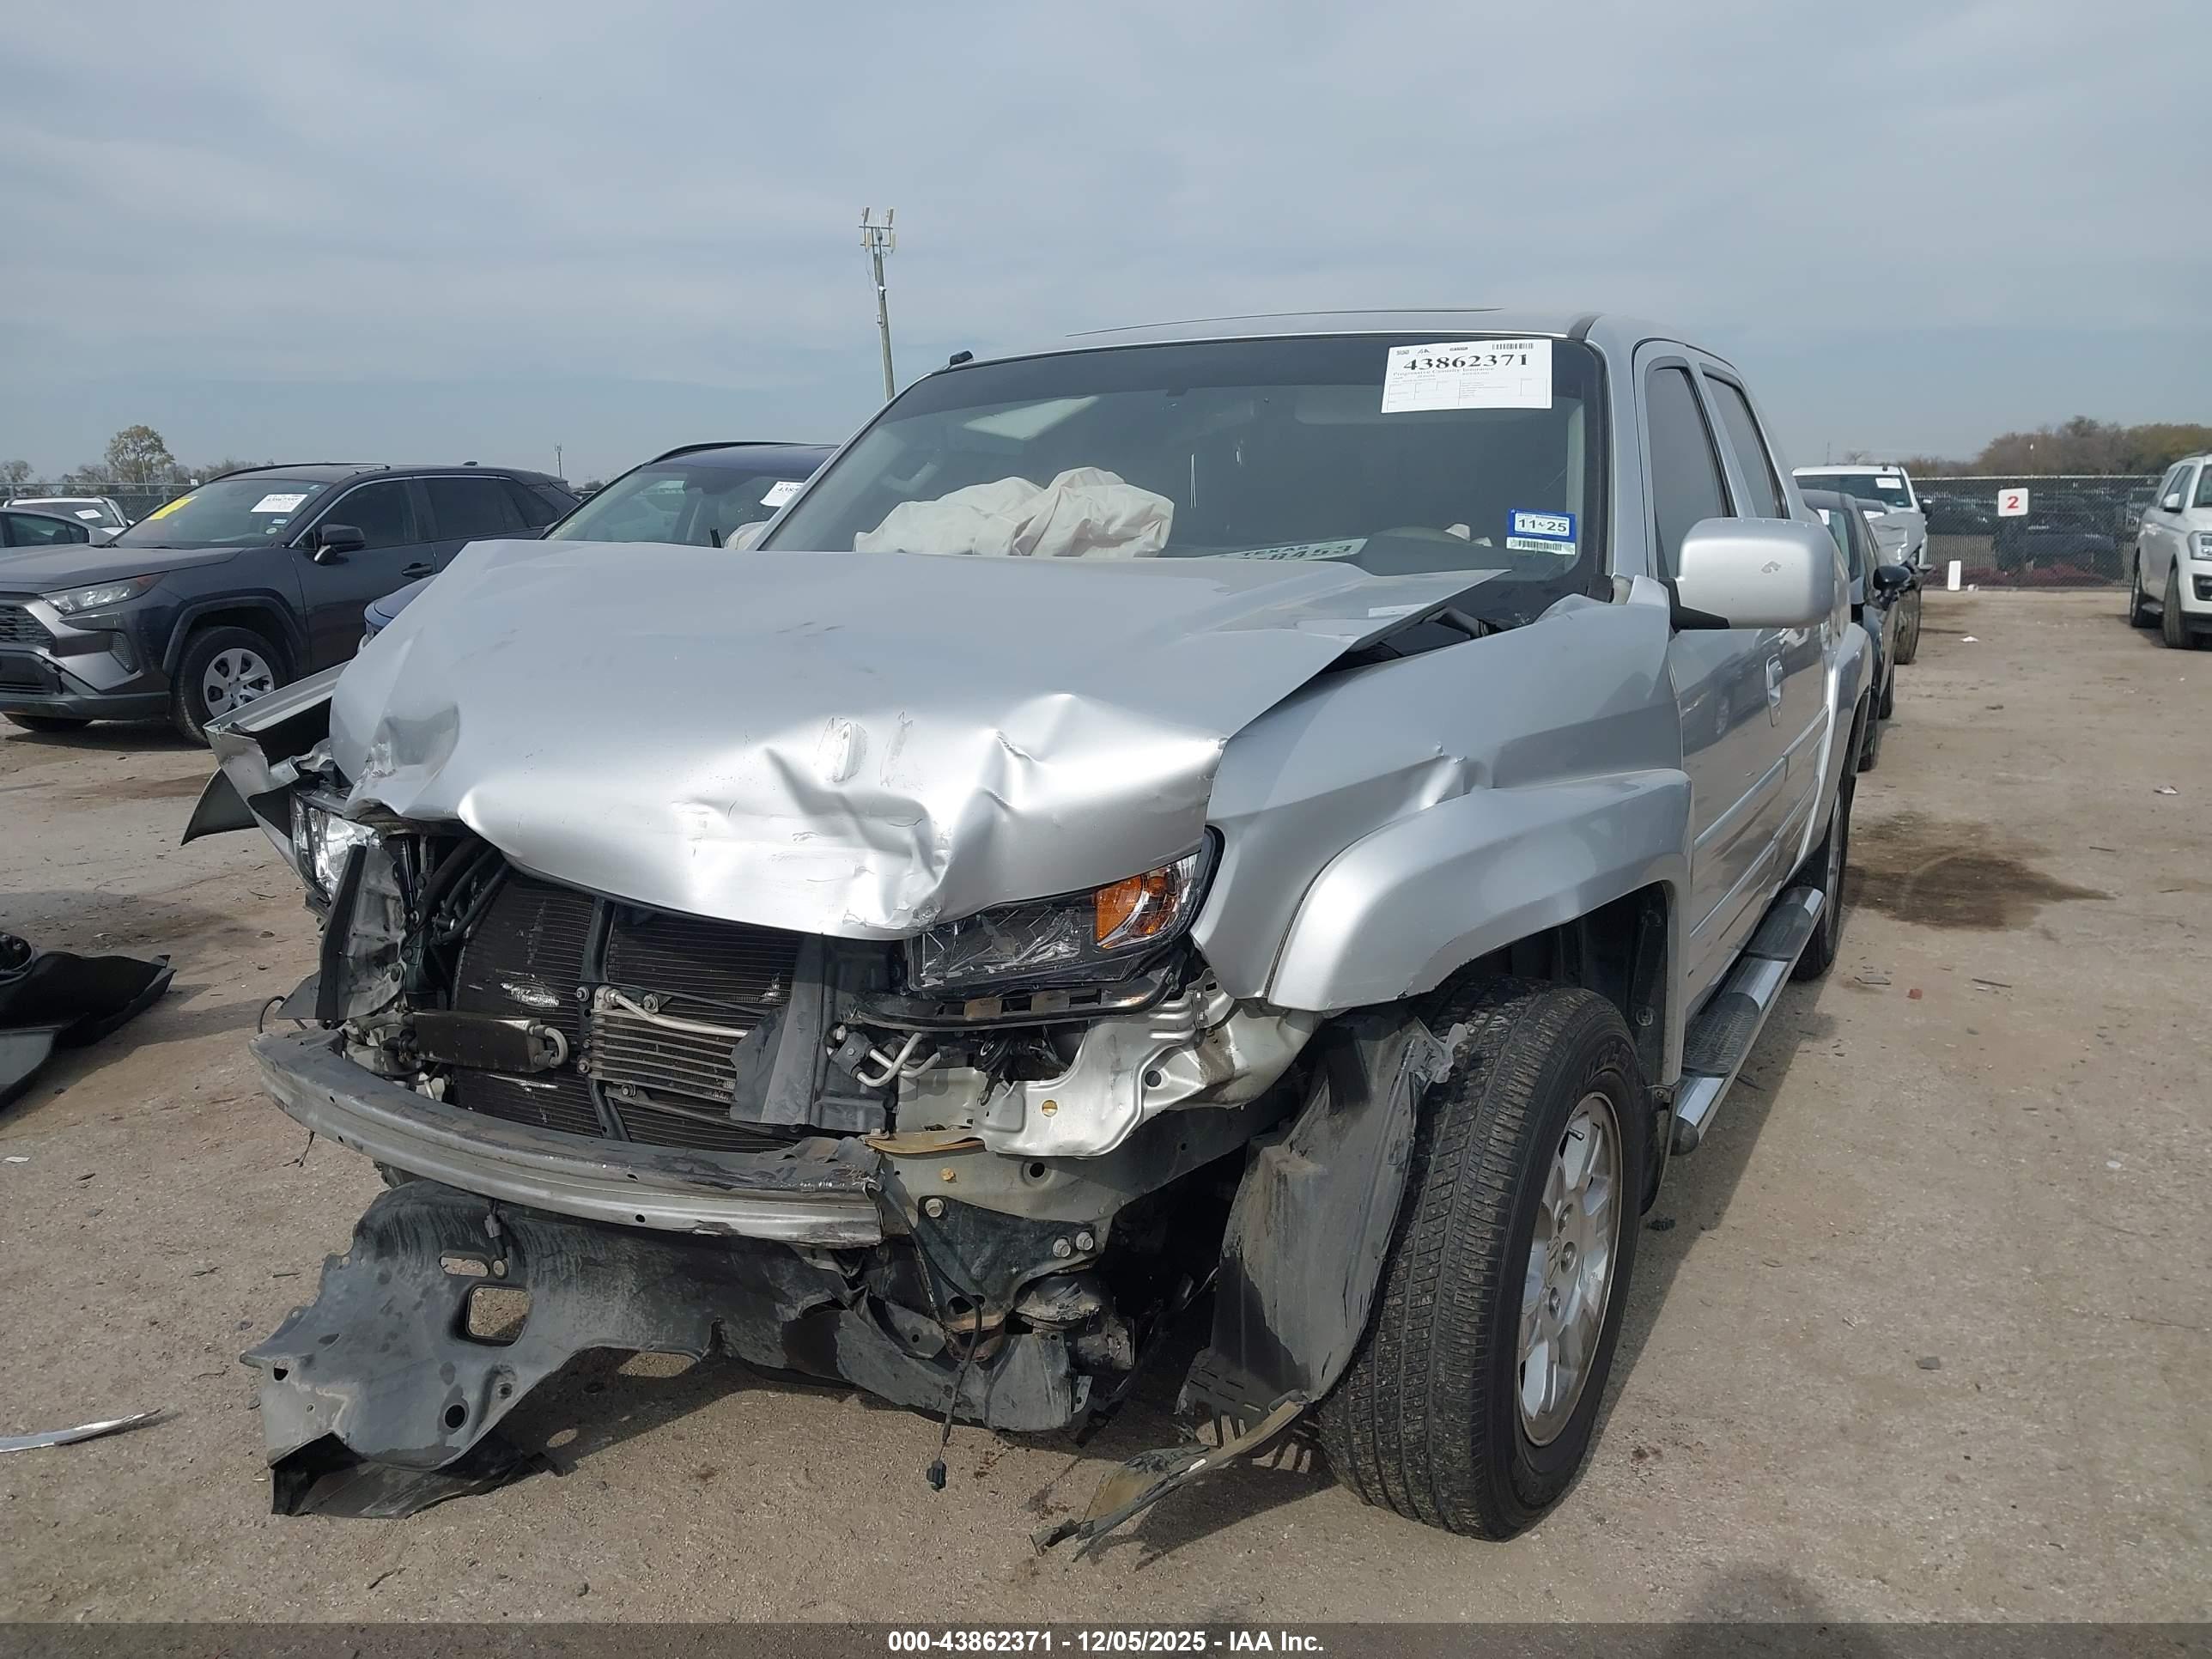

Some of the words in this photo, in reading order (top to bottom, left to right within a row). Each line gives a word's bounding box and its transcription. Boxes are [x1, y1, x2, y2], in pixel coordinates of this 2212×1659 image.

[1403, 353, 1528, 370] 43862371
[2007, 495, 2019, 508] 2
[1242, 545, 1310, 556] TEXAS
